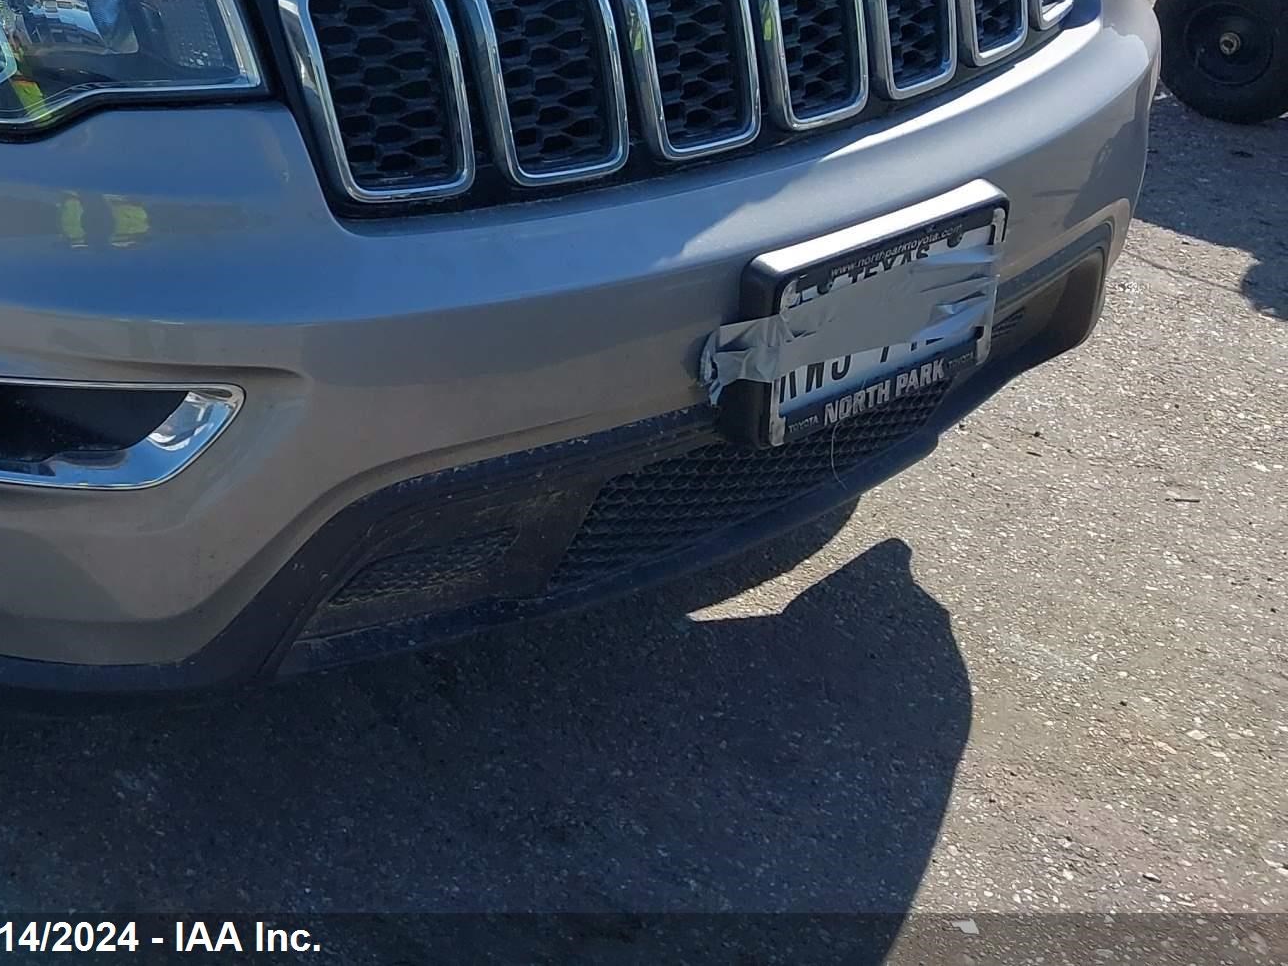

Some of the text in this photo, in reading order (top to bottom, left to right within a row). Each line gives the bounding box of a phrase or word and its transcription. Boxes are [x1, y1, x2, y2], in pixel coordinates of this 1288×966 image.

[788, 416, 820, 433] TOYOTA
[824, 380, 891, 426] NORTH
[896, 358, 945, 397] PARK
